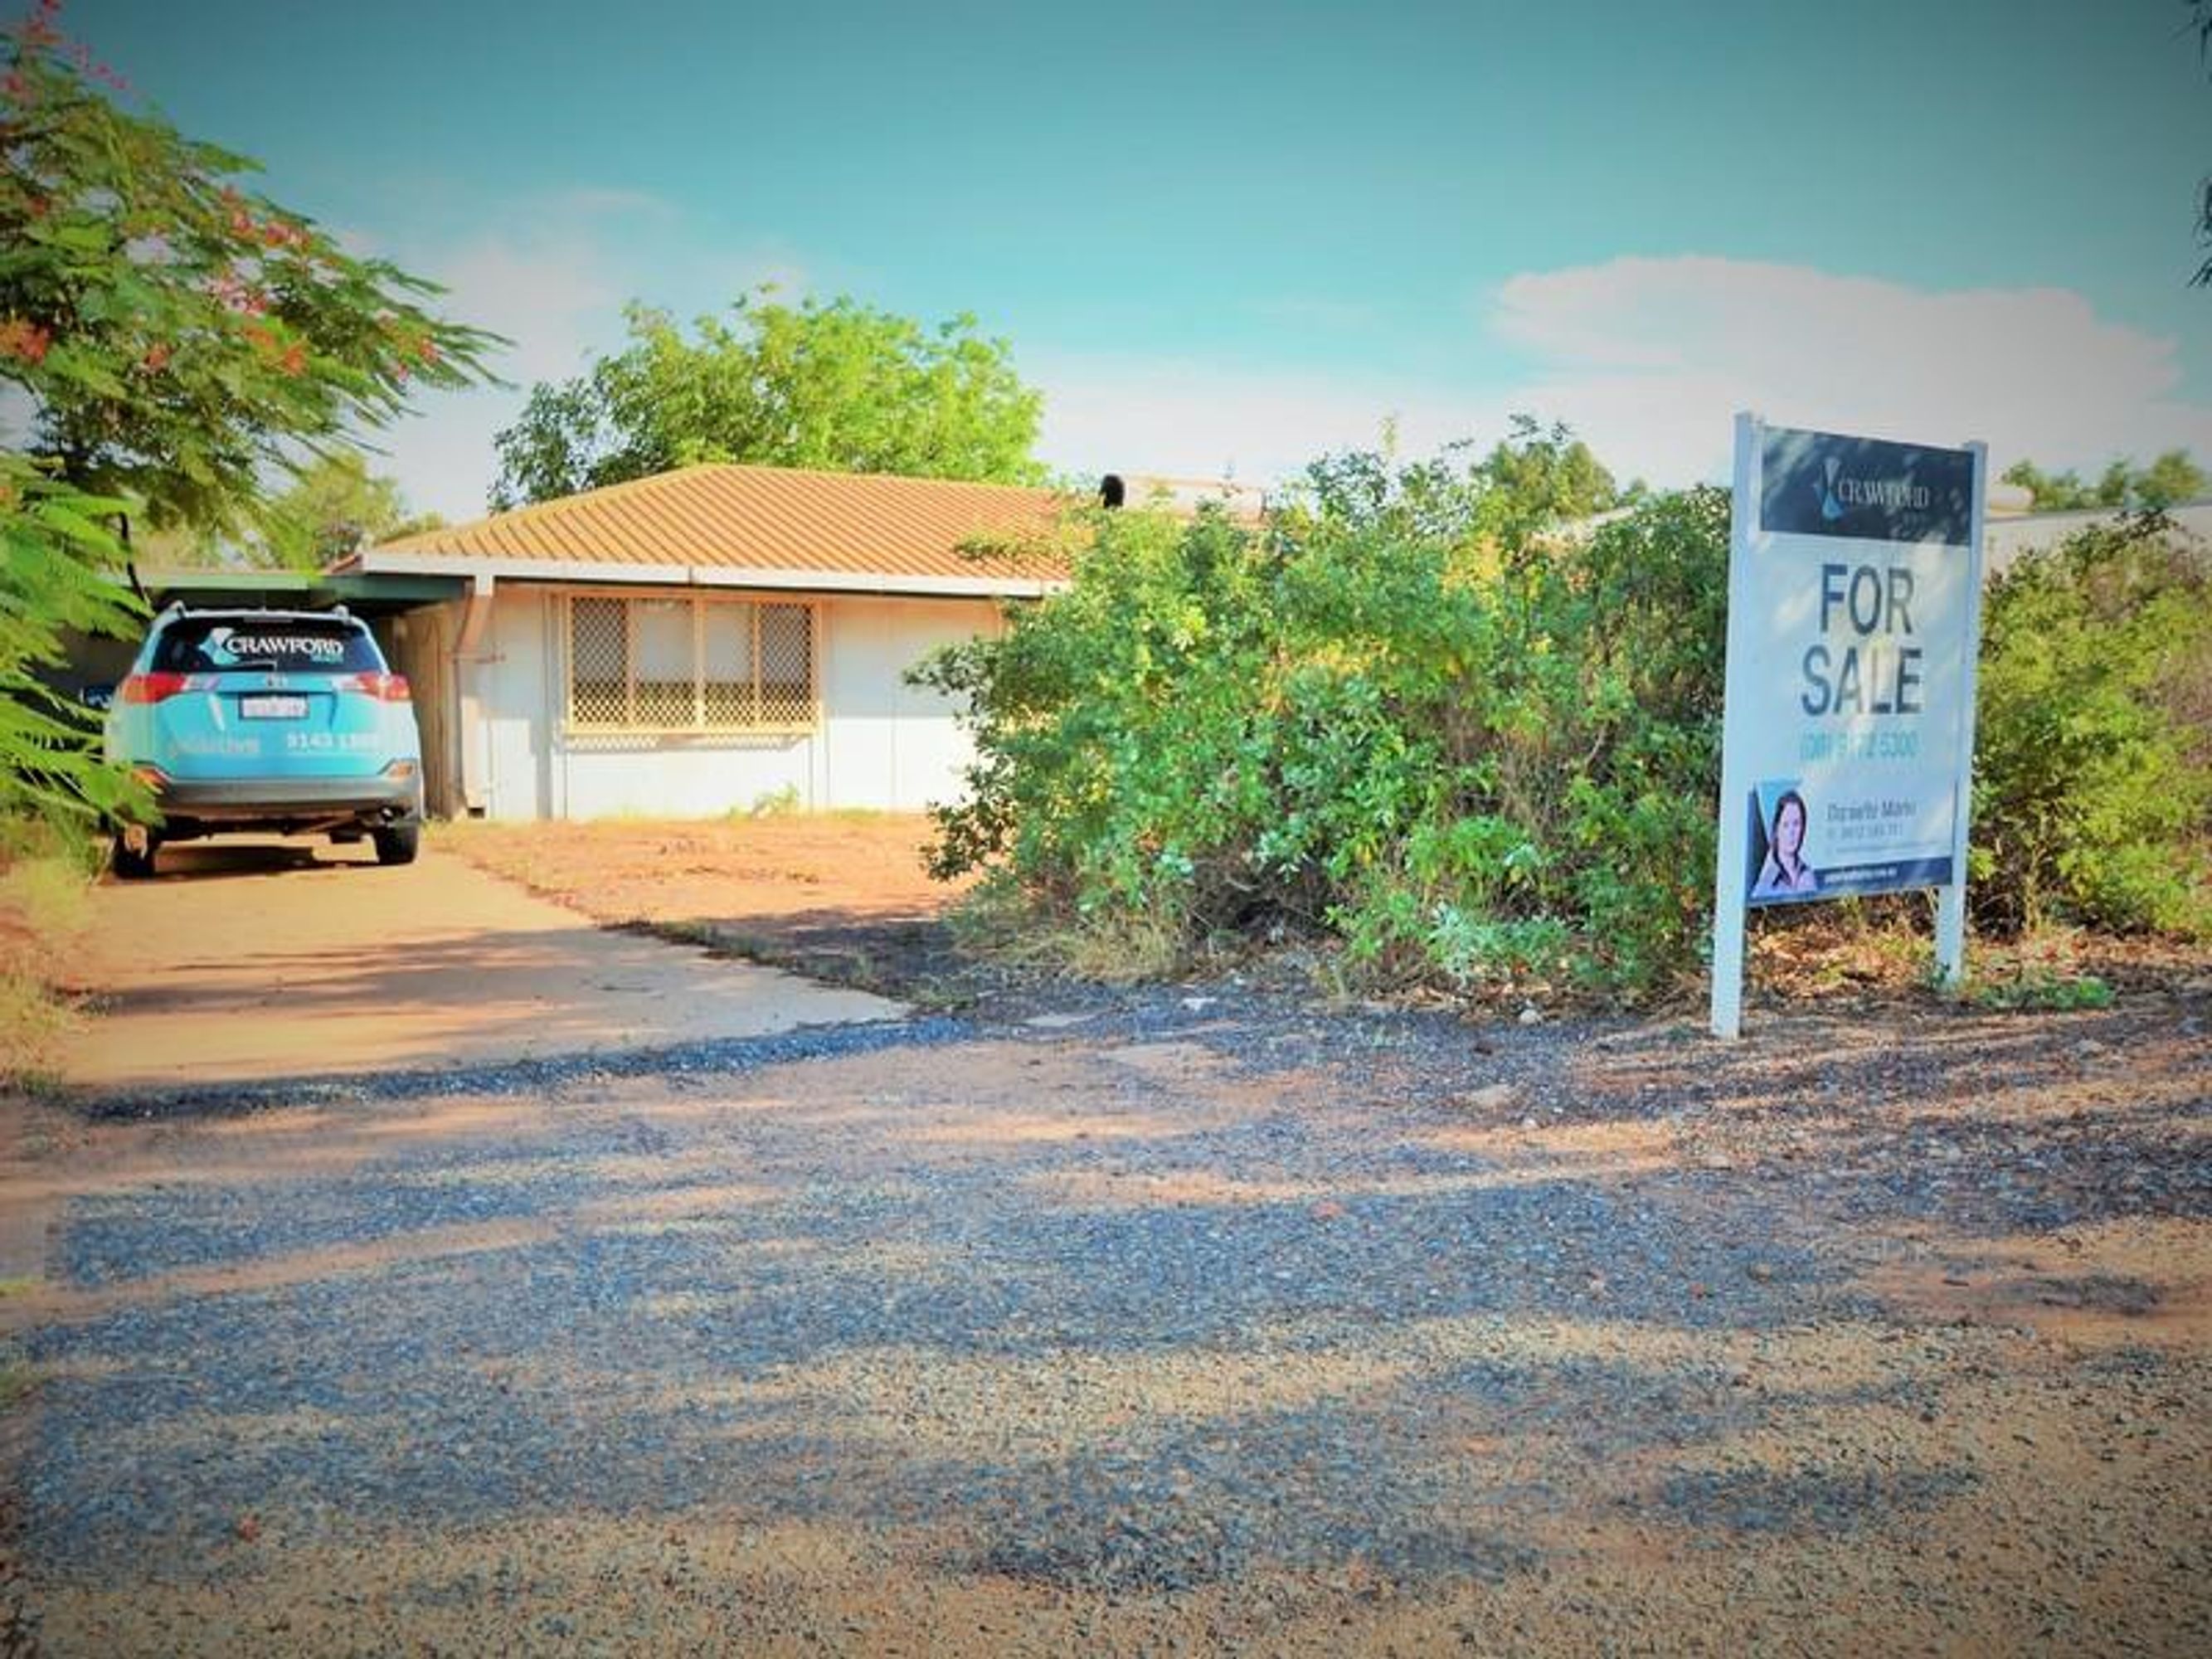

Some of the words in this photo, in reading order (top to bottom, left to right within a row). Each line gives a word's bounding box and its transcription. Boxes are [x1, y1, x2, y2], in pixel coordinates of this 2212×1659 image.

[1837, 479, 1929, 508] CRAWFORD
[1820, 564, 1914, 635] FOR
[226, 636, 344, 654] CRAWFORD
[1801, 645, 1923, 717] SALE
